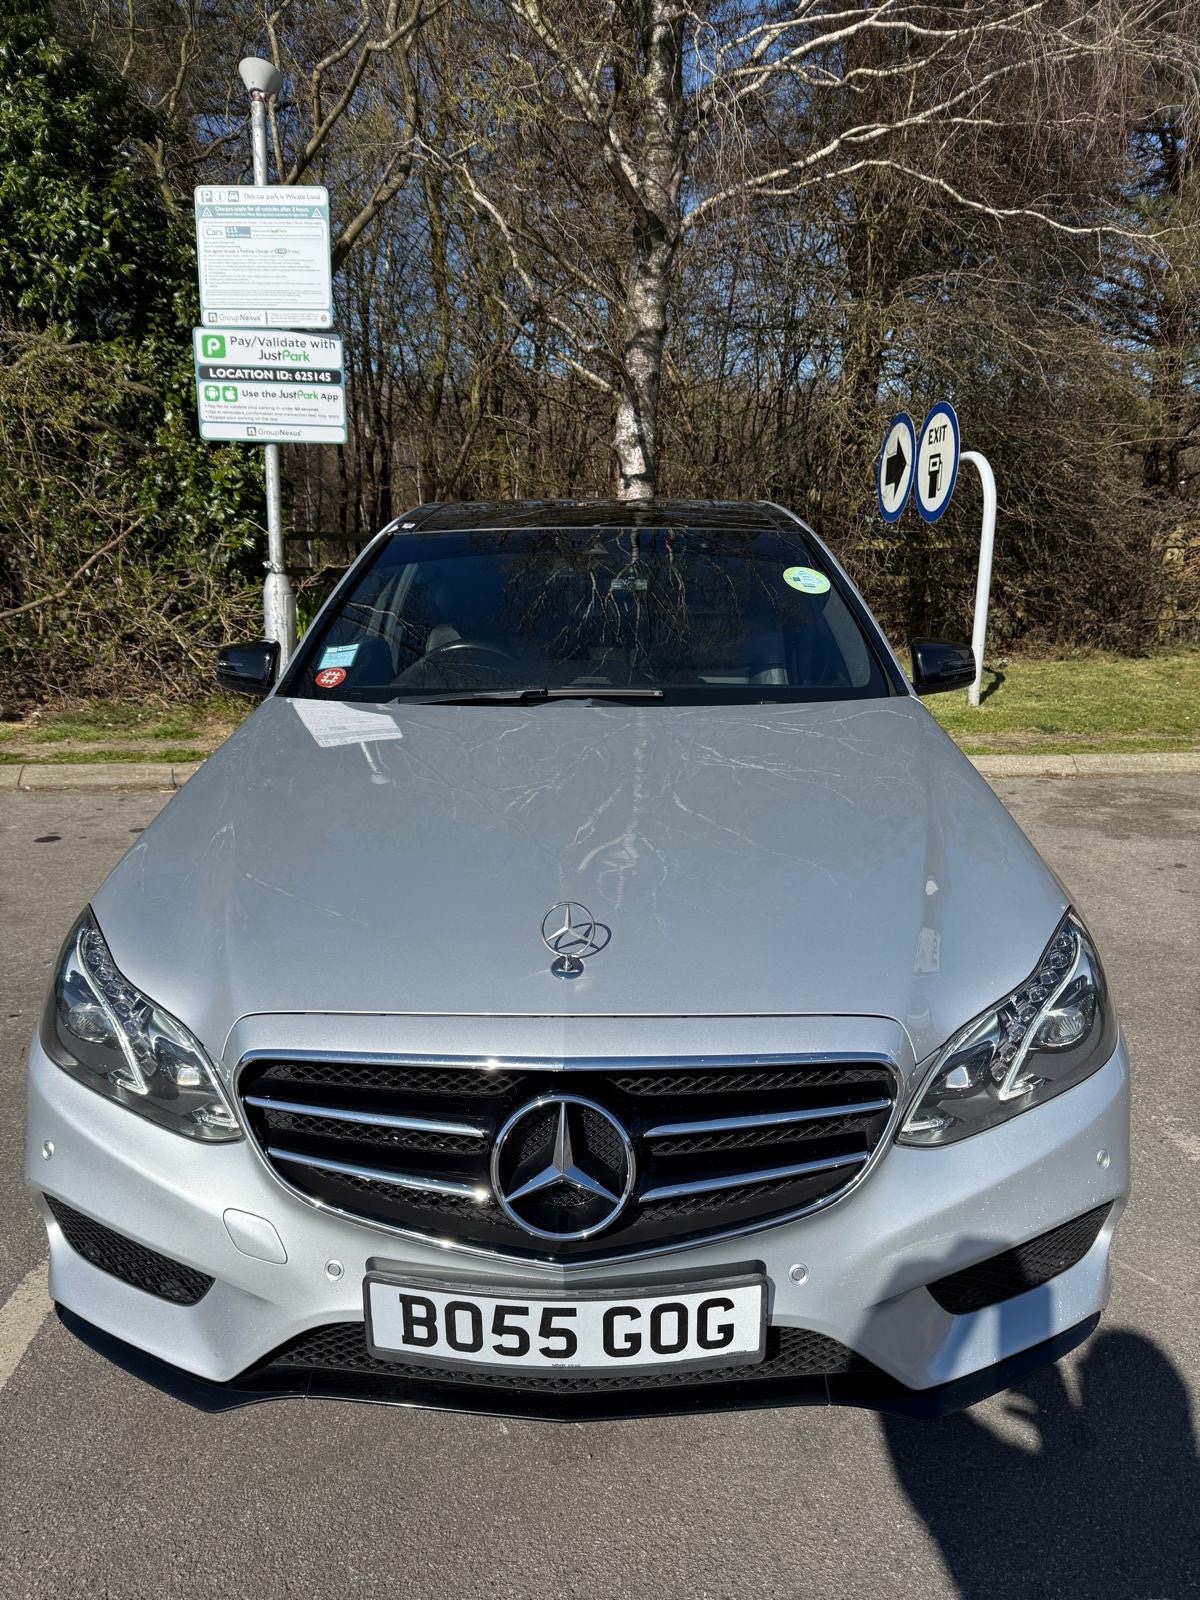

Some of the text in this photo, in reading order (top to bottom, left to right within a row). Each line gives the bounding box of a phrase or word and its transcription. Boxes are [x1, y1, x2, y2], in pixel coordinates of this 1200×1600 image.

[266, 193, 279, 201] park
[205, 227, 223, 236] Cars
[230, 336, 336, 350] Pay/Validate with
[258, 349, 311, 362] JustPark
[209, 368, 332, 382] LOCATION ID: 625145
[241, 389, 339, 402] Use the JustPark App
[928, 424, 948, 446] EXIT
[399, 1293, 735, 1359] BO55 GOG
